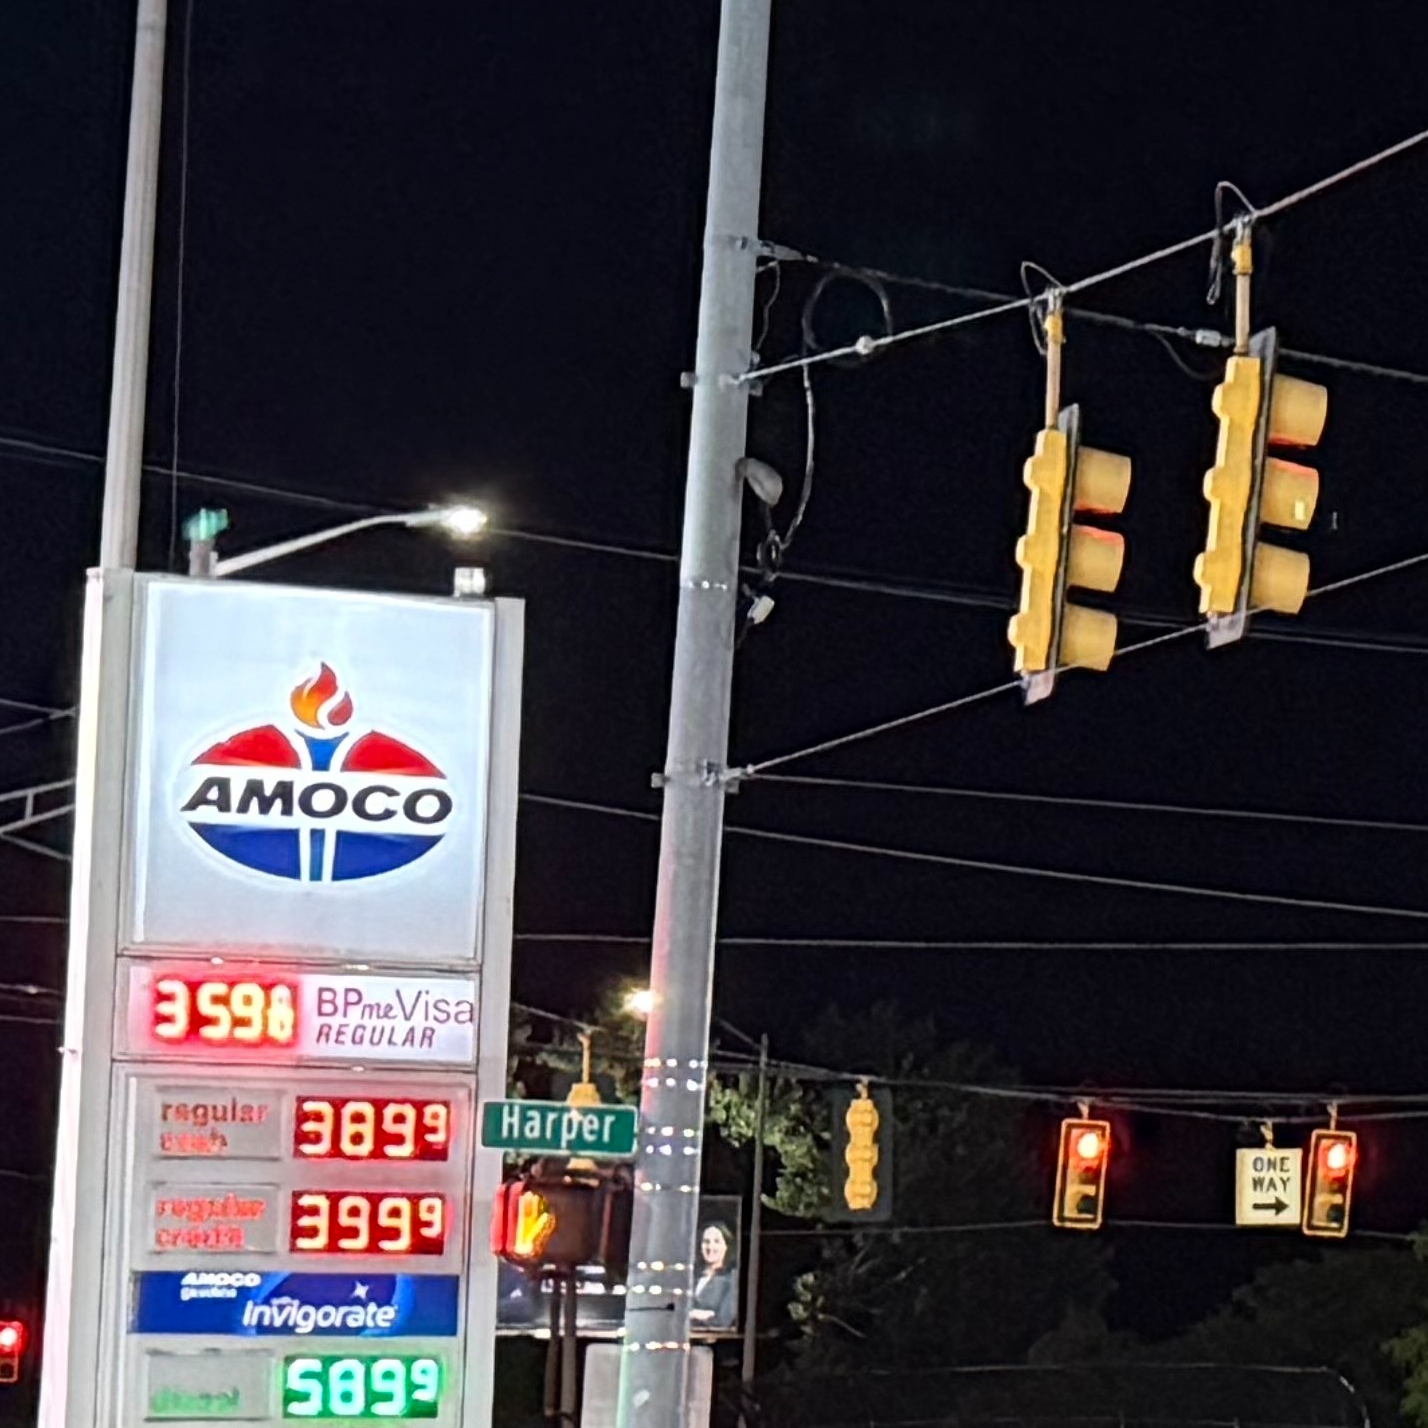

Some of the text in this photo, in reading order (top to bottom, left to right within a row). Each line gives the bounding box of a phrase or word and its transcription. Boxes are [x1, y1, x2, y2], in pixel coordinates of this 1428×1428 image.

[180, 775, 453, 825] AMOCO
[316, 1023, 436, 1049] REGULAR
[502, 1105, 616, 1149] Harper
[1252, 1156, 1290, 1173] ONE
[1252, 1176, 1291, 1193] WAY
[181, 1272, 262, 1288] AMOCO
[242, 1300, 396, 1334] Invigorate
